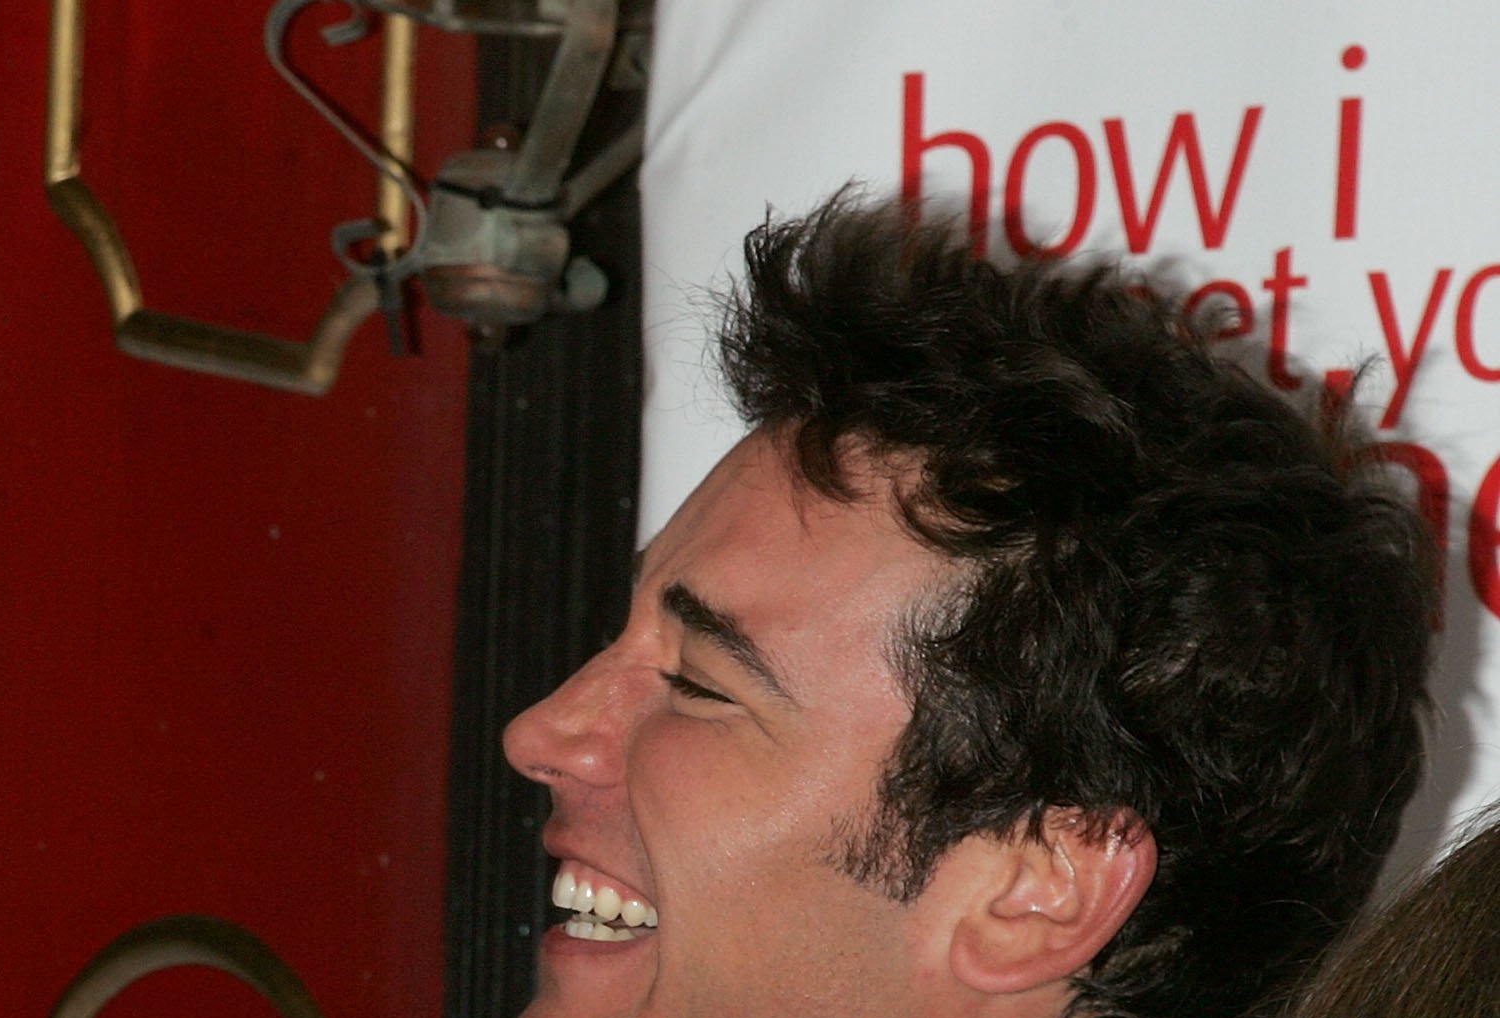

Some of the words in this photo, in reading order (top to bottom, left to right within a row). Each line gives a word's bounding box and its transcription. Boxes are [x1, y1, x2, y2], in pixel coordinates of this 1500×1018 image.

[901, 71, 1264, 261] how
[1332, 44, 1368, 241] i
[1128, 247, 1308, 391] et
